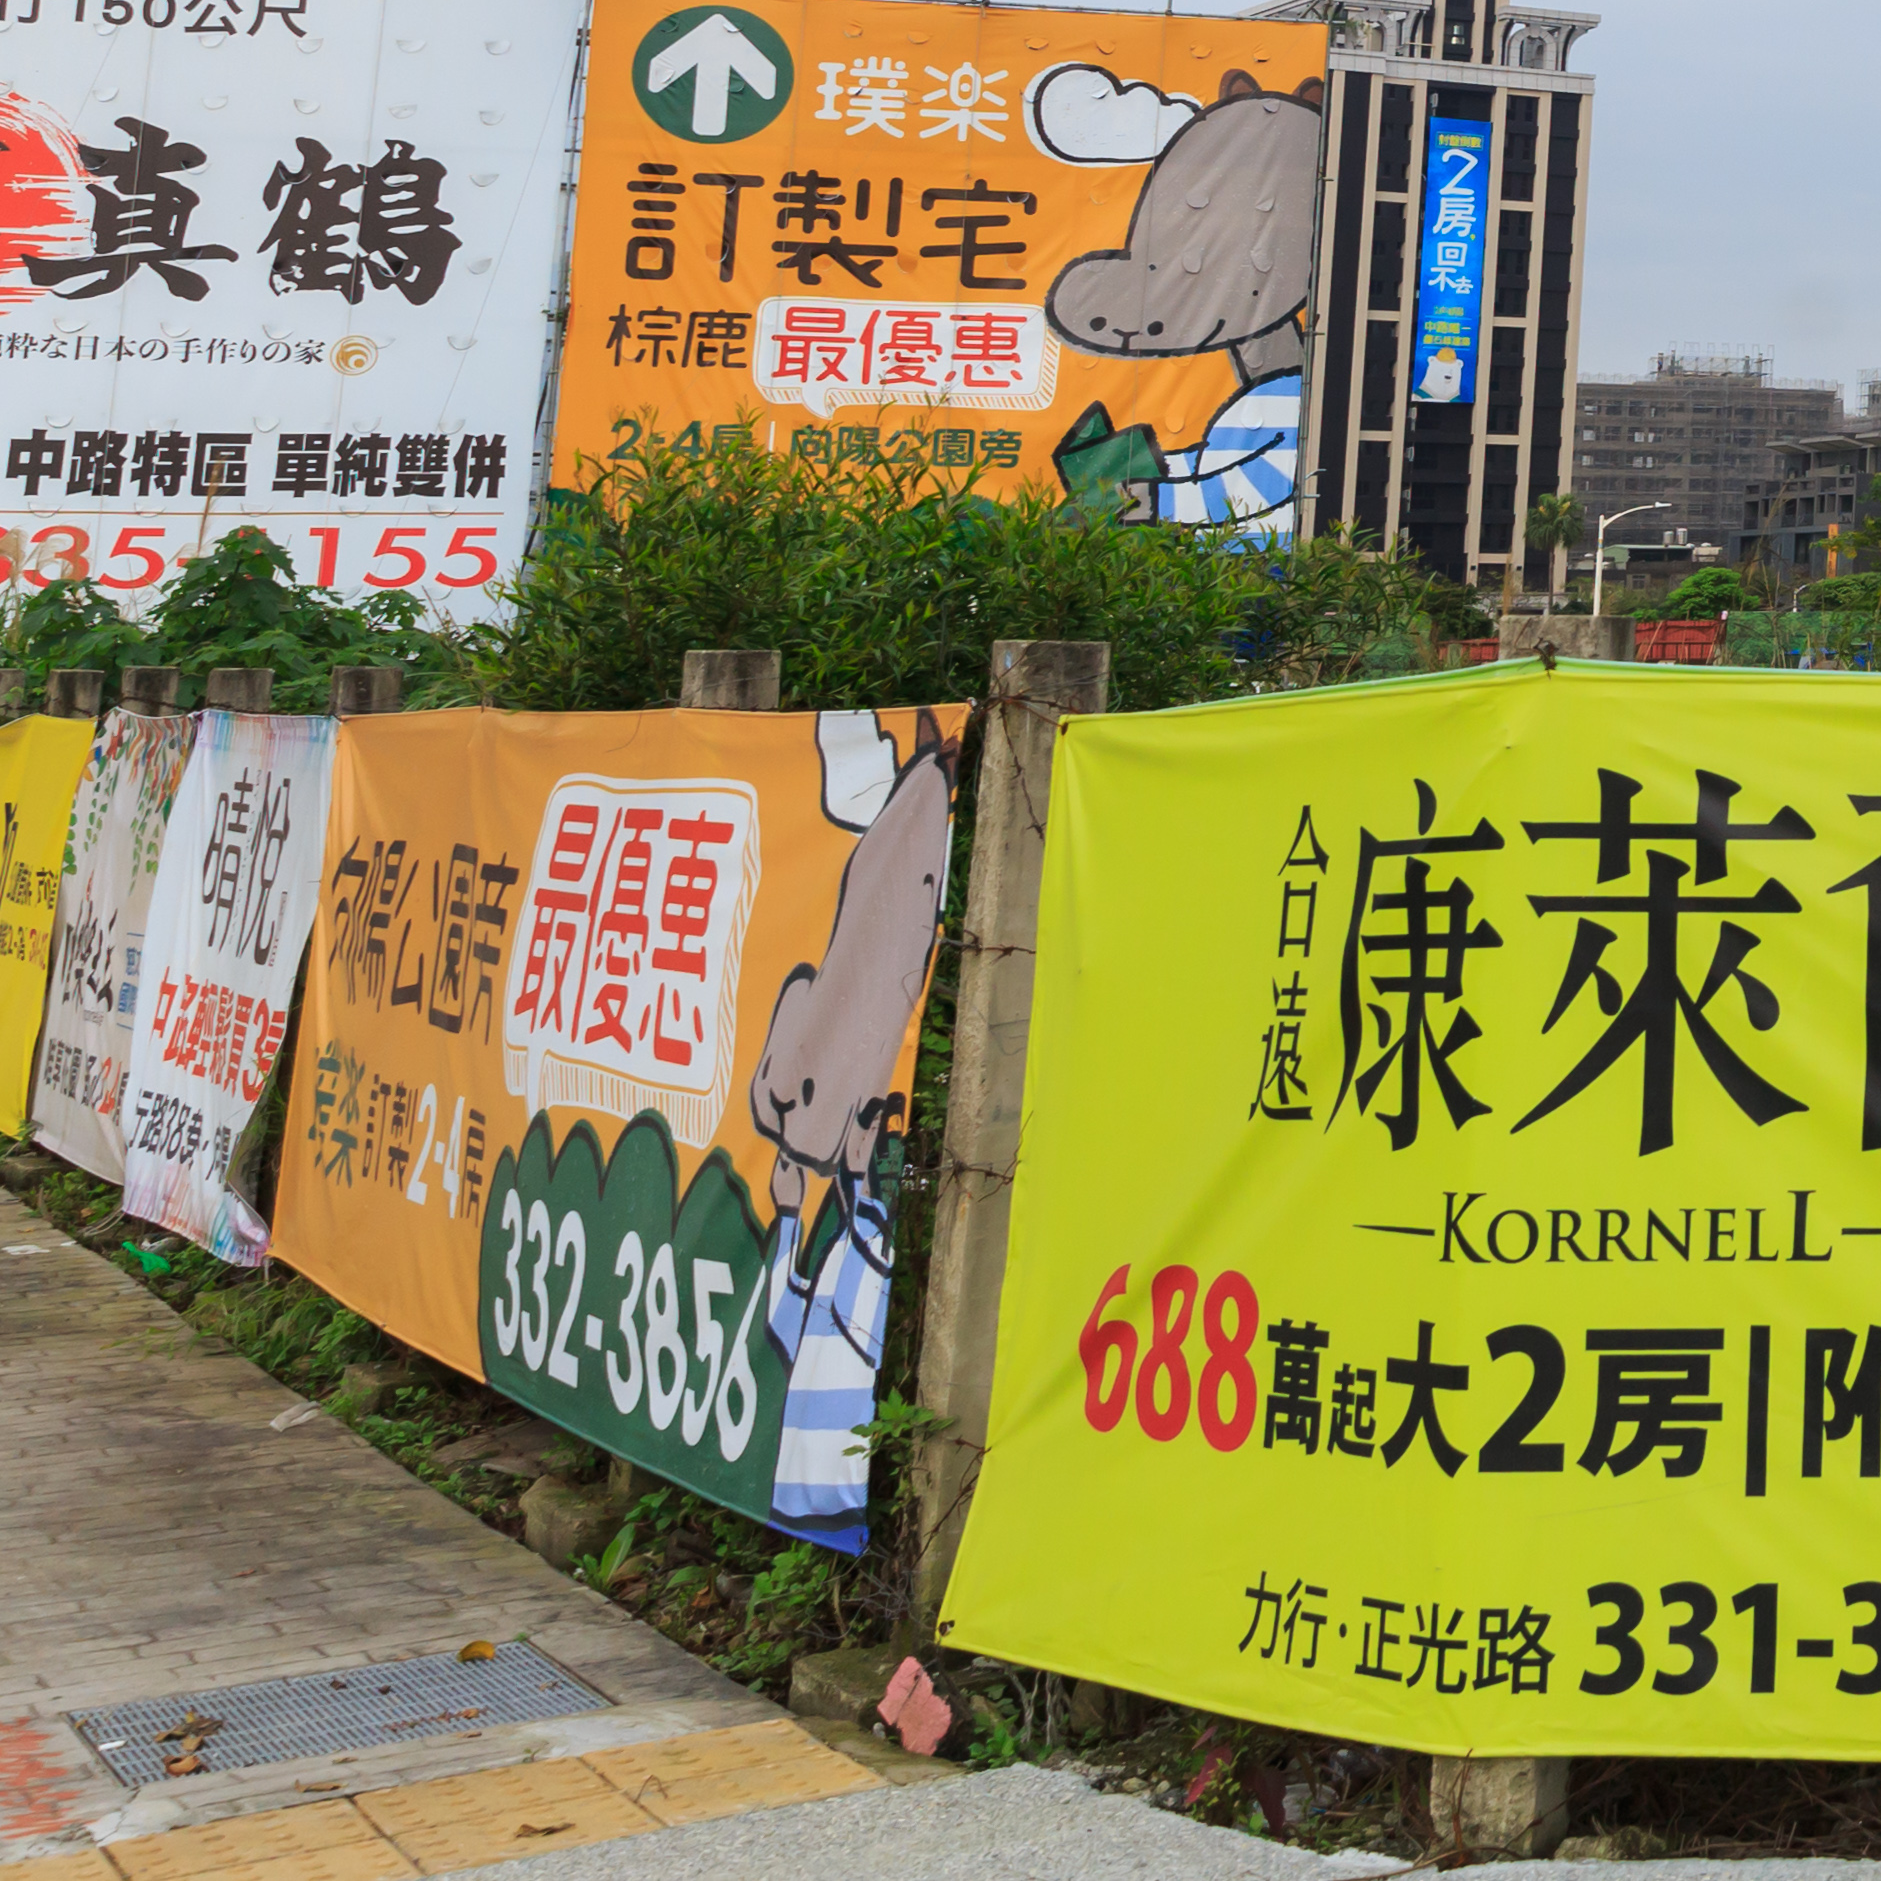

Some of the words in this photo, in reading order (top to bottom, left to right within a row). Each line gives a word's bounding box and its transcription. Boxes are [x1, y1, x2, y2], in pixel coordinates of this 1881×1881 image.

[814, 56, 1010, 143] 璞楽
[20, 116, 463, 306] 真鶴
[625, 163, 1037, 291] 訂製宅
[1427, 149, 1478, 295] 2房回不去
[0, 332, 326, 365] 粋な日本の手作りの家
[606, 304, 753, 369] 棕鹿
[772, 306, 1028, 390] 最優惠
[6, 429, 253, 497] 中路特區
[271, 431, 506, 498] 單純雙併
[791, 426, 1024, 469] 向陽公園旁
[0, 525, 499, 590] 35-155
[202, 767, 291, 965] 晴悅
[328, 835, 519, 1045] 向陽公園旁
[515, 804, 734, 1067] 最優惠
[1248, 805, 1330, 1122] 合遠
[1439, 1190, 1833, 1265] KORRNELL
[493, 1187, 768, 1463] 332-3856
